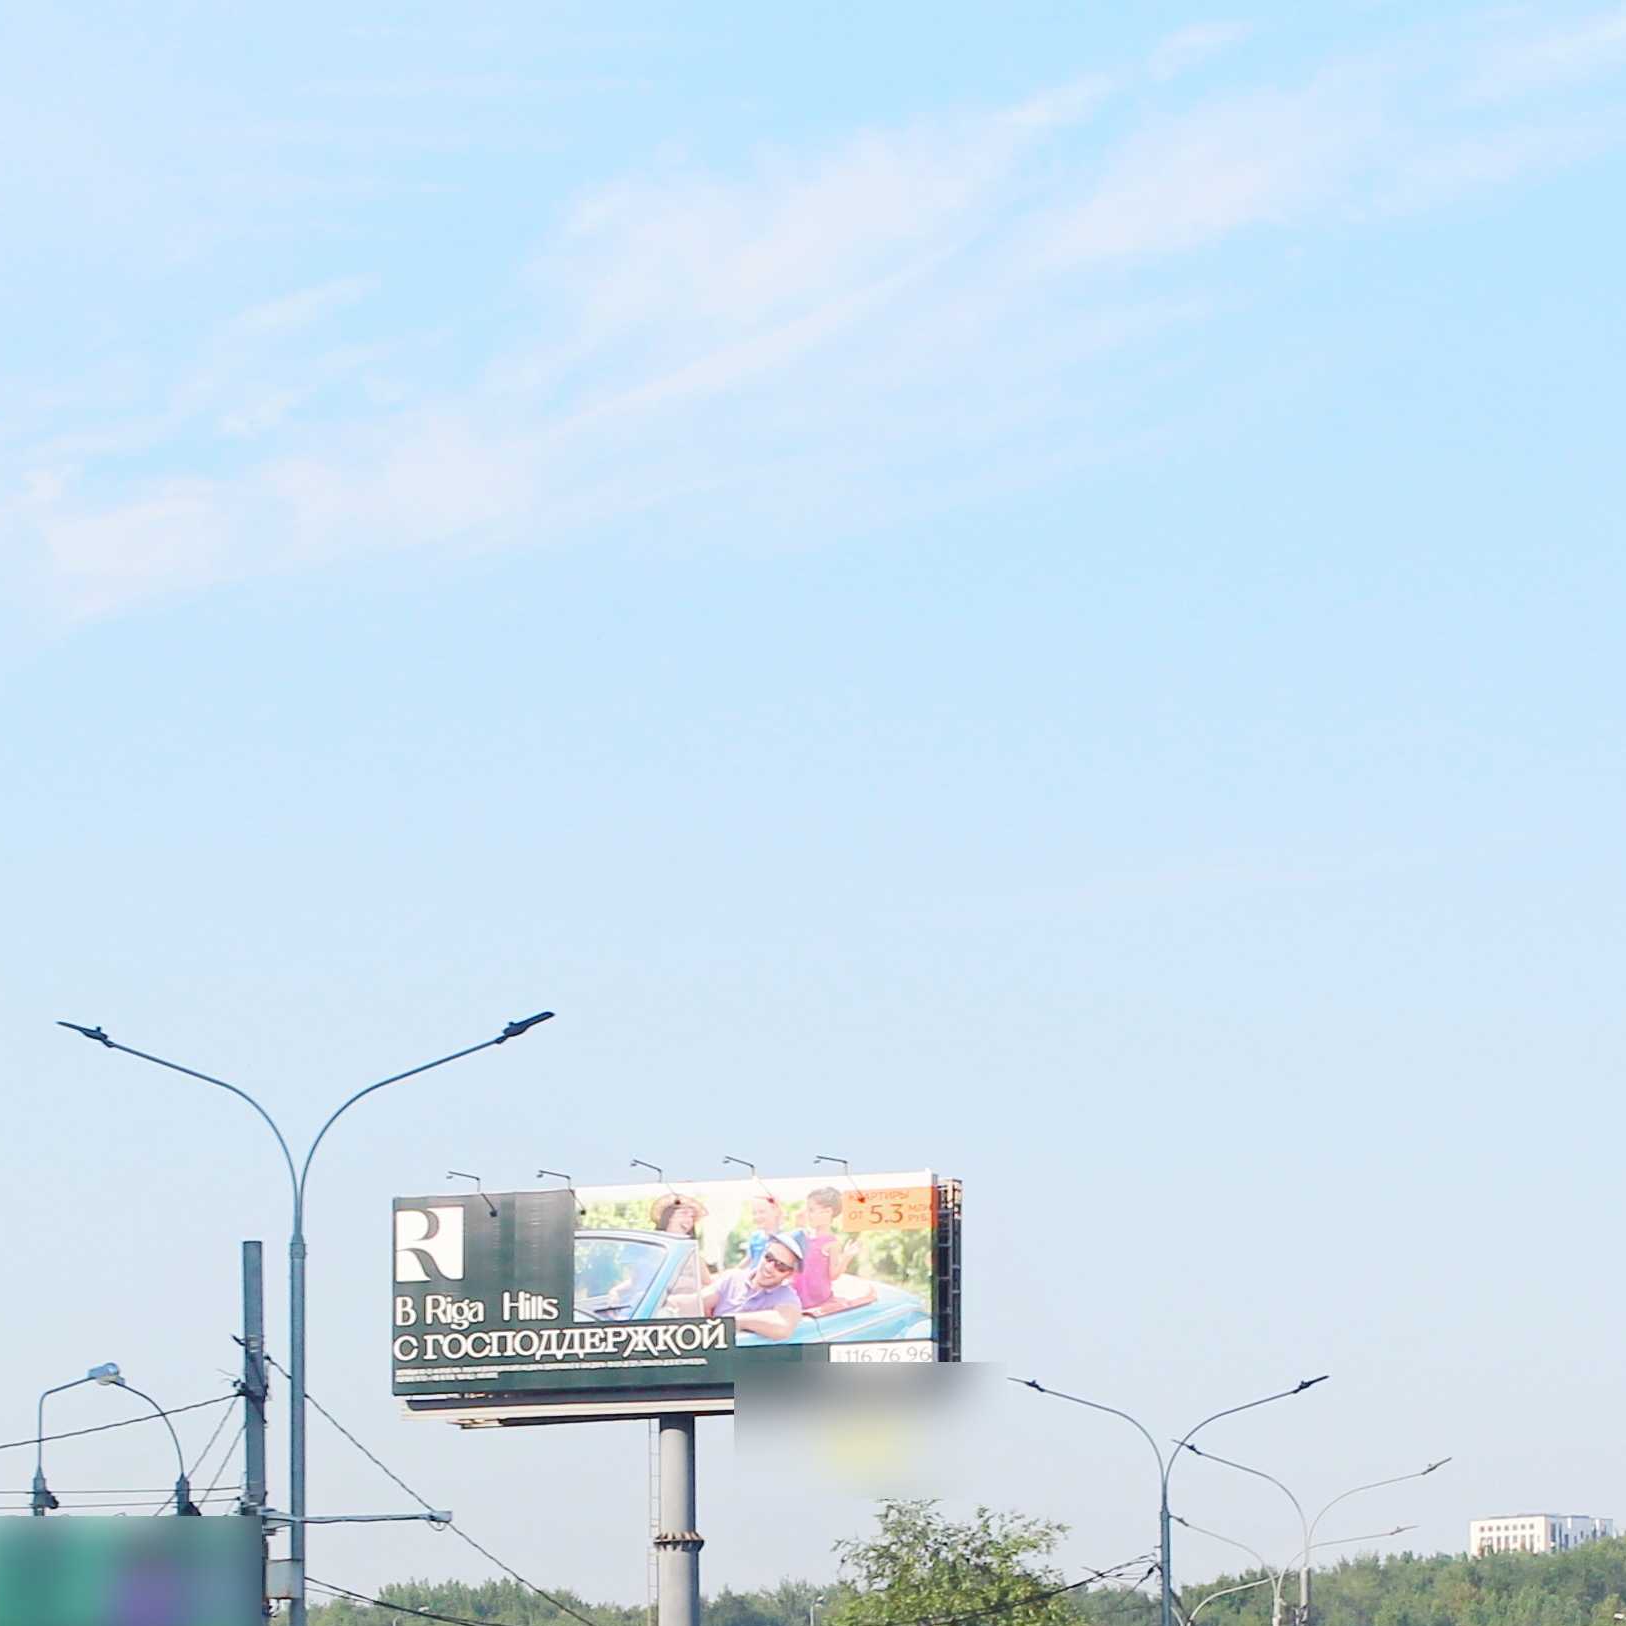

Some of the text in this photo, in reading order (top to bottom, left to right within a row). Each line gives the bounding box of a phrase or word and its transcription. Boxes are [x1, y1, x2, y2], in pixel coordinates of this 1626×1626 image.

[868, 1203, 903, 1224] 5.3
[395, 1291, 560, 1331] В Riga Hills
[393, 1318, 728, 1361] С ГОСПОДДЕРЖКОЙ
